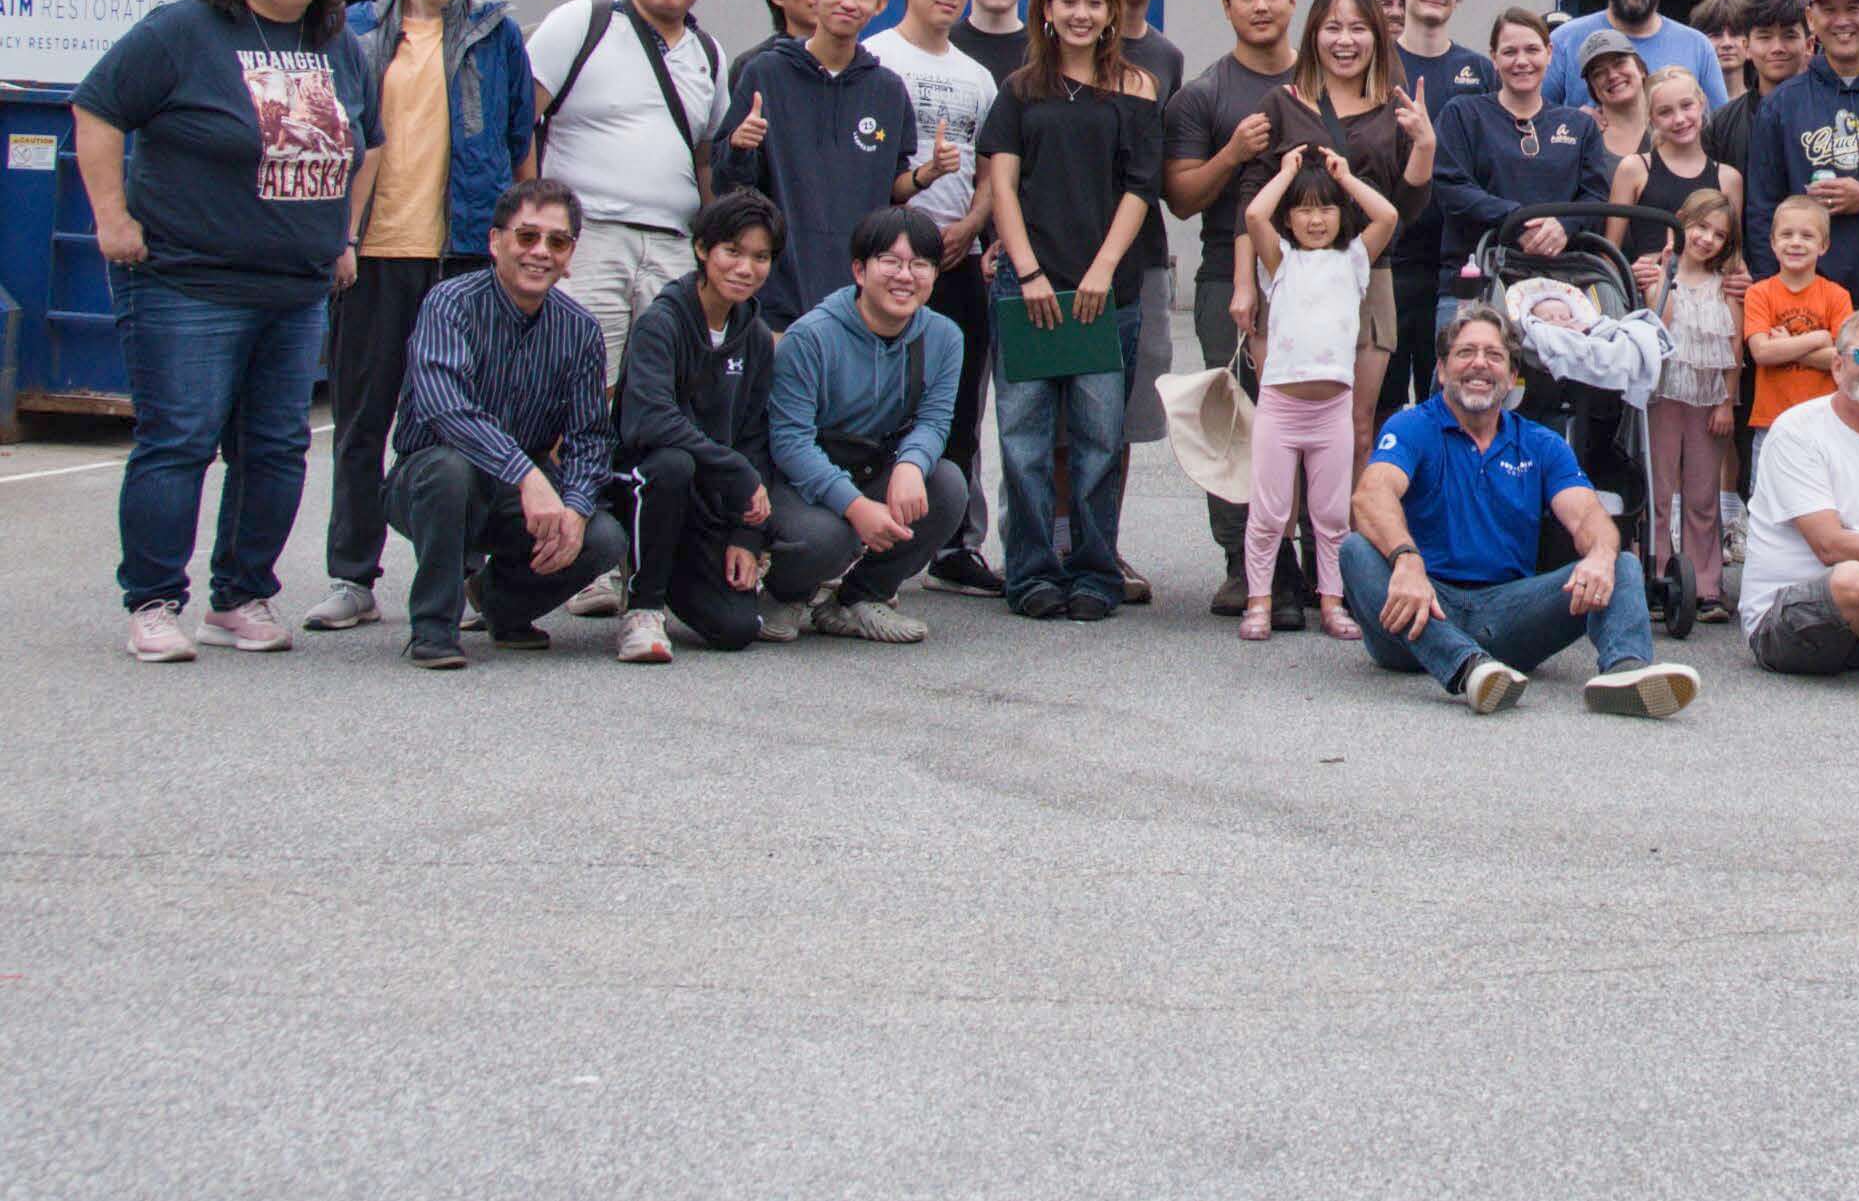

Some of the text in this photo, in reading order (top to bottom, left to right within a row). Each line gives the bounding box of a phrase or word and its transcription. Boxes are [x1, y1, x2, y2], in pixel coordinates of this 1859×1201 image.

[29, 37, 117, 52] RESTORATIO
[236, 50, 334, 72] WRANGELL
[262, 159, 348, 198] ALASKA
